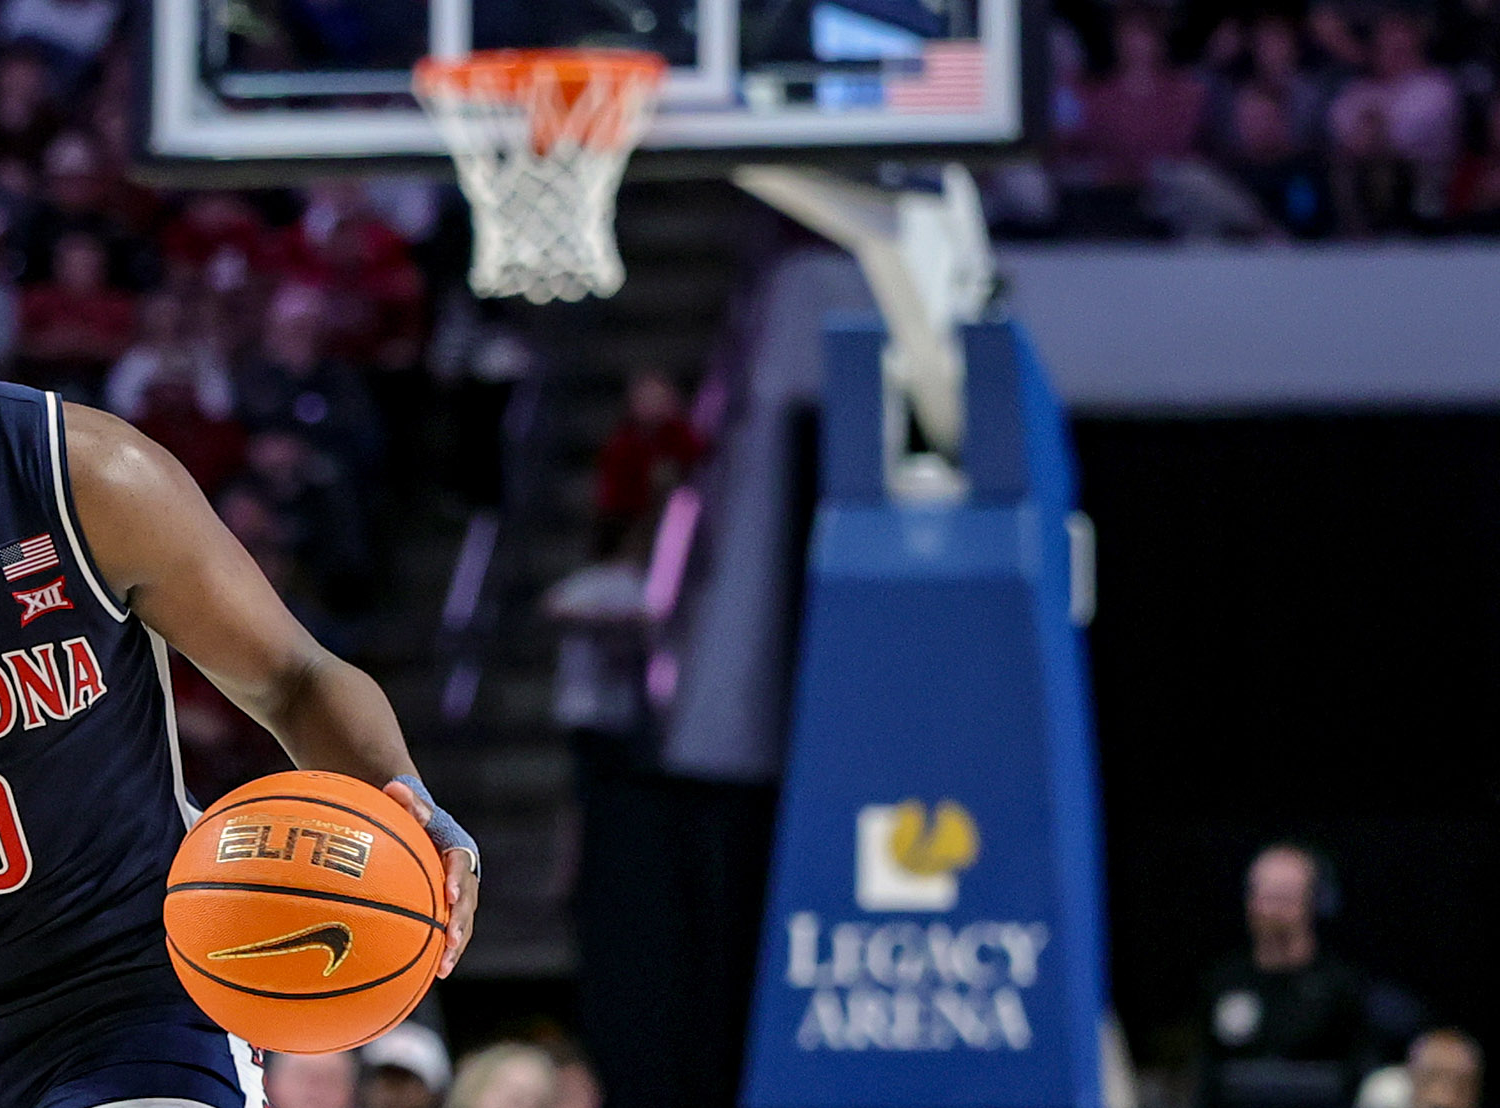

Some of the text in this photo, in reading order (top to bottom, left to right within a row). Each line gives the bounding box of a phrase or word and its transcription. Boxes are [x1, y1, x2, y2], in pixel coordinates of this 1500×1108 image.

[17, 582, 68, 621] XII
[216, 824, 372, 881] ELITE
[786, 910, 1052, 989] LEGACY
[795, 986, 1034, 1052] ARENA
